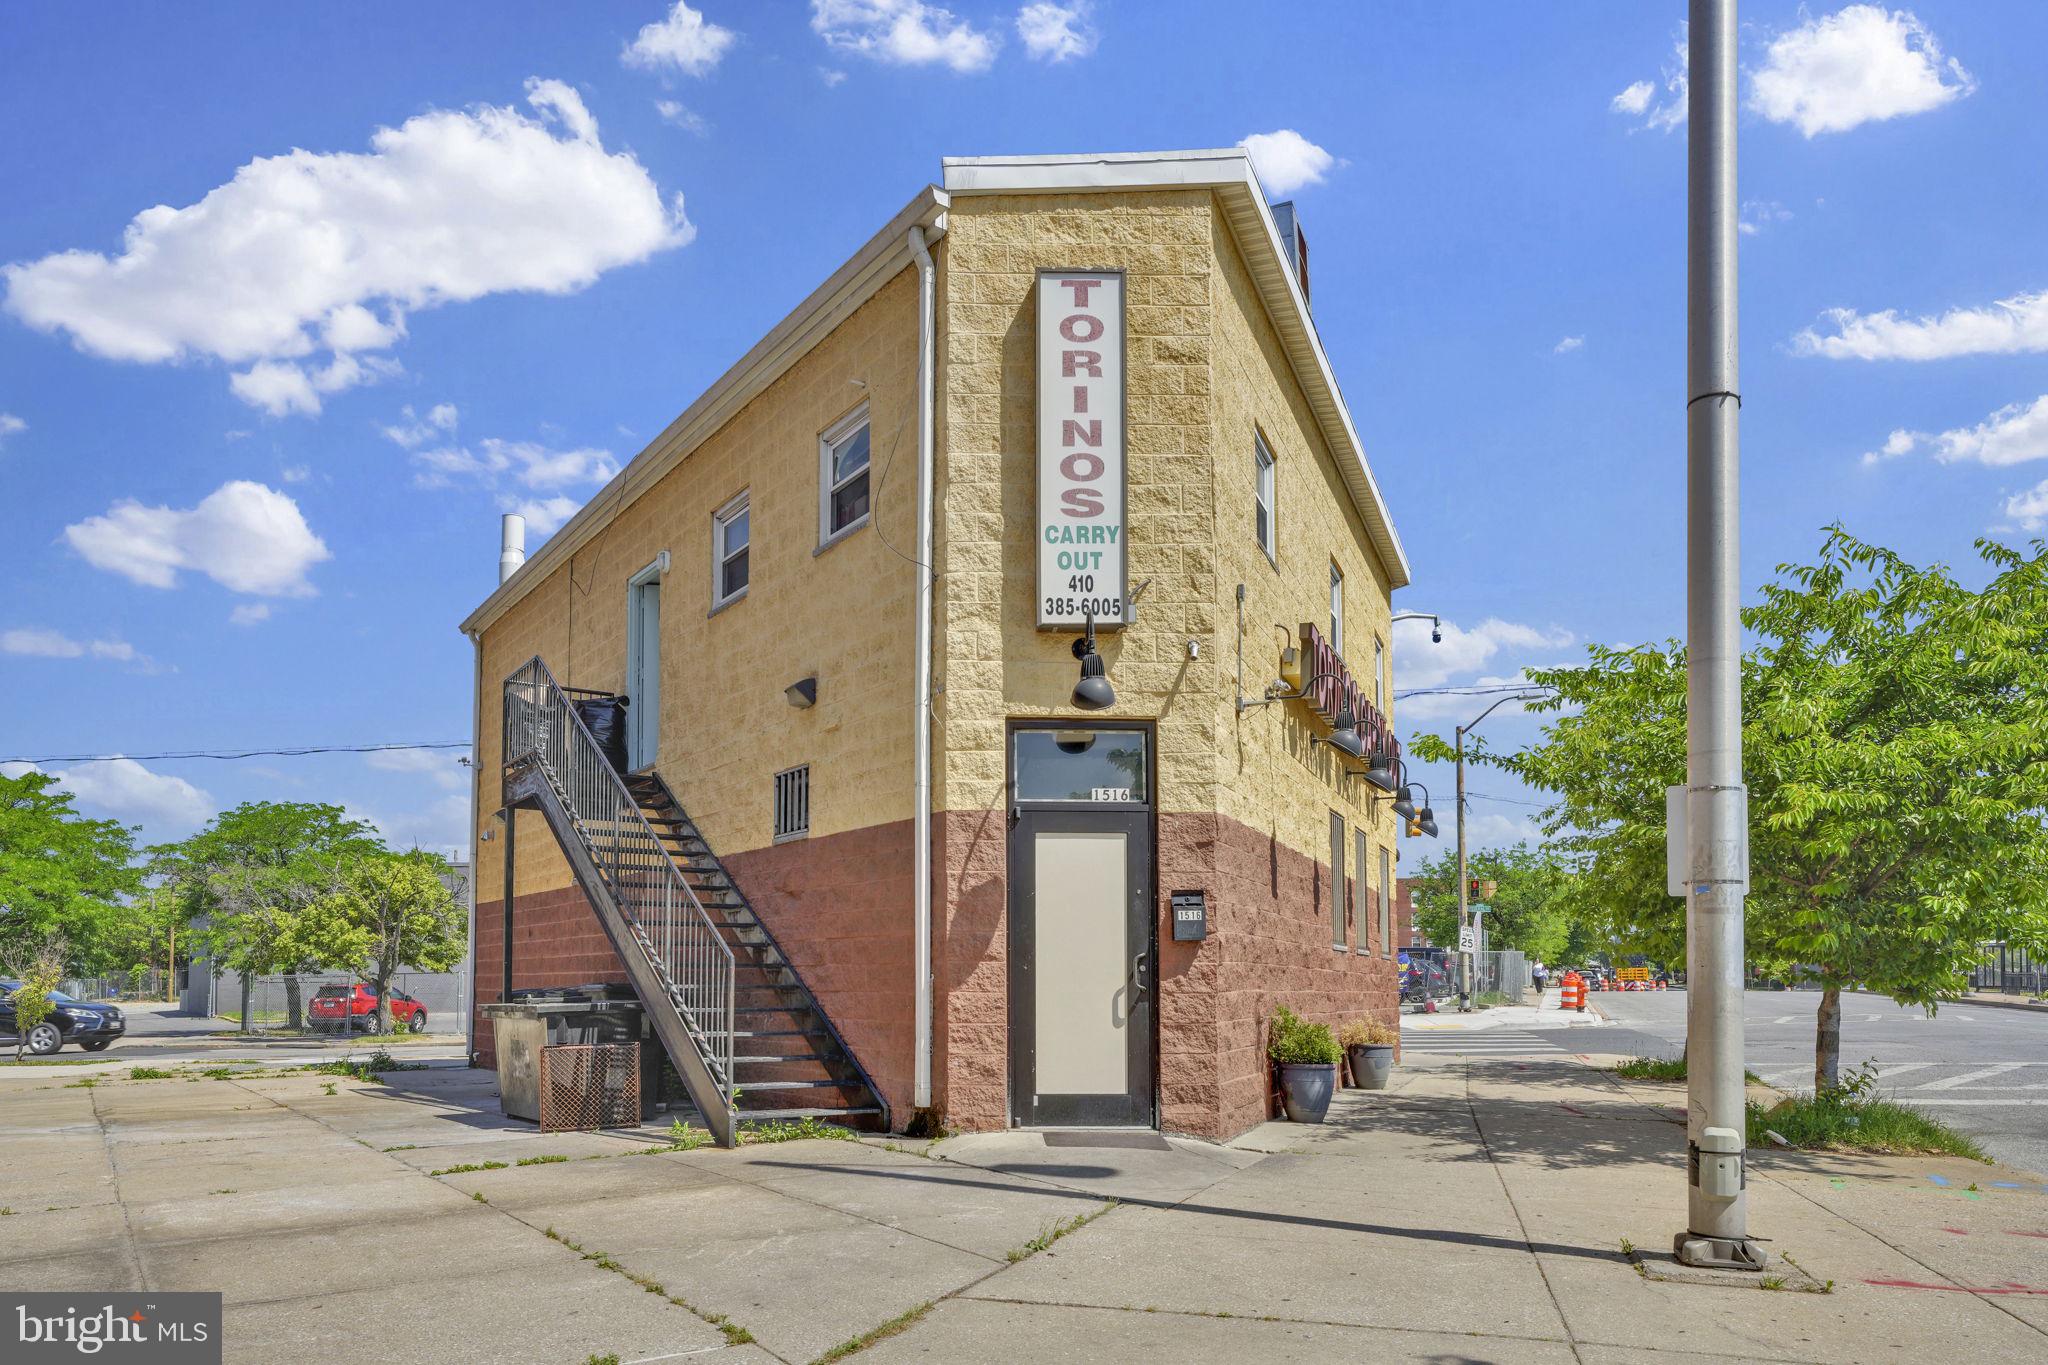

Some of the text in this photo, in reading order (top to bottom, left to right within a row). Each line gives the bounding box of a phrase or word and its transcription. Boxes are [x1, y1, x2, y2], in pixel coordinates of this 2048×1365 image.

[1059, 280, 1105, 518] TORINOS
[1045, 525, 1120, 545] CARRY
[1057, 551, 1103, 571] OUT
[1068, 574, 1094, 593] 410
[1045, 597, 1121, 616] 385-6005
[1094, 789, 1128, 801] 1516
[1179, 911, 1201, 920] 1516
[1461, 937, 1473, 948] 25
